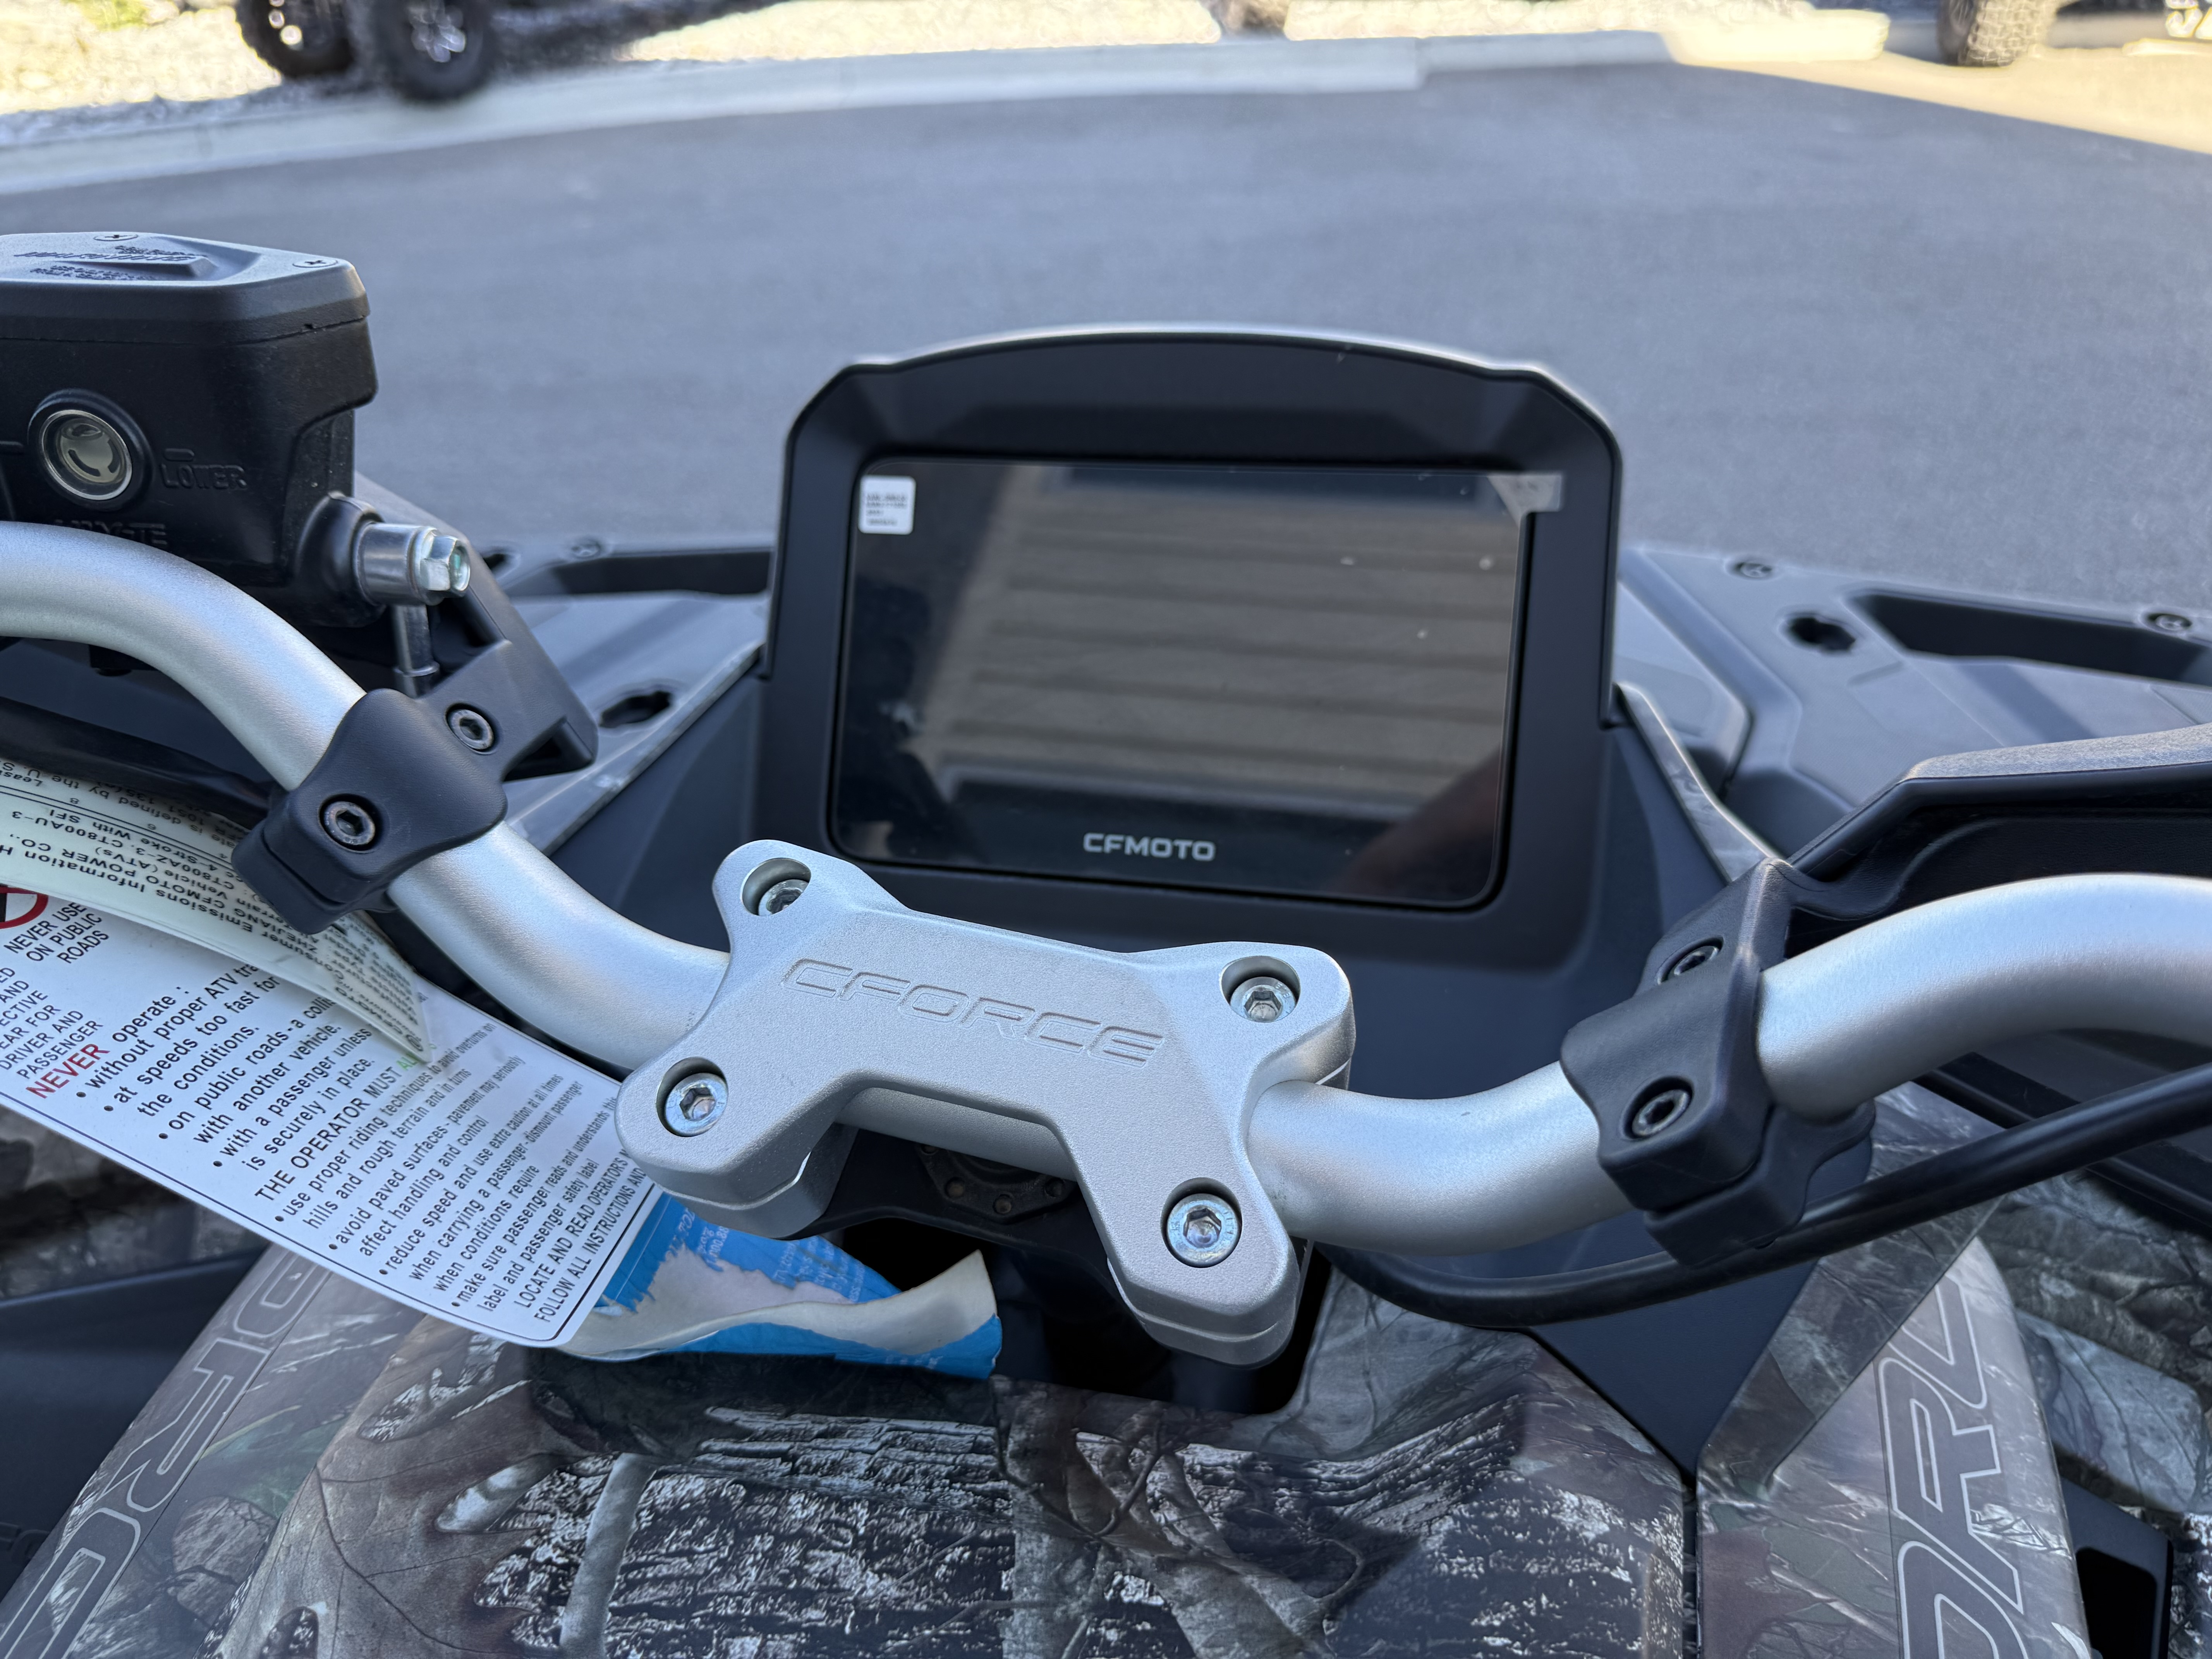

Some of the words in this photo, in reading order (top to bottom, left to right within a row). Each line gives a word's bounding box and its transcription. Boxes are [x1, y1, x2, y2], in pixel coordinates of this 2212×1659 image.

[161, 463, 247, 490] LOWER
[0, 770, 43, 787] Leas
[52, 775, 79, 789] the
[89, 785, 110, 799] by
[50, 809, 81, 823] SFI
[118, 797, 182, 824] defined
[12, 811, 124, 848] CT800AU-3
[93, 822, 132, 840] With
[190, 824, 203, 835] is
[1082, 832, 1216, 862] CFMOTO
[24, 850, 145, 893] Information
[62, 848, 136, 877] POWER
[95, 847, 158, 873] (ATVs)
[141, 838, 218, 871] 4-Stroke
[146, 875, 225, 909] CFMOTO
[165, 869, 228, 900] Vehicle
[3, 921, 59, 954] NEVER
[52, 902, 88, 922] USE
[156, 889, 253, 933] Emissions
[26, 943, 55, 962] ON
[49, 913, 103, 946] PUBLIC
[57, 930, 110, 964] ROADS
[234, 908, 318, 954] ZHEJIANG
[262, 931, 344, 980] Consumer
[0, 981, 29, 1003] AND
[25, 1005, 62, 1027] FOR
[781, 957, 1165, 1067] CFORCE
[0, 1032, 55, 1070] DRIVER
[52, 1010, 84, 1033] AND
[25, 1044, 111, 1099] NEVER
[112, 995, 176, 1043] operate
[84, 1039, 155, 1089] without
[153, 996, 208, 1041] proper
[204, 973, 239, 1000] ATV
[113, 1085, 138, 1103] at
[137, 1038, 199, 1085] speeds
[195, 1015, 228, 1036] too
[223, 990, 261, 1013] fast
[254, 976, 281, 993] for
[16, 1020, 104, 1079] PASSENGER
[137, 1094, 173, 1117] the
[173, 1025, 260, 1091] conditions.
[193, 1113, 235, 1144] with
[233, 1061, 292, 1111] another
[289, 1024, 342, 1061] vehicle.
[440, 1081, 456, 1093] in
[447, 1068, 472, 1085] turns
[541, 1073, 565, 1093] times
[168, 1111, 196, 1130] on
[194, 1067, 247, 1110] public
[219, 1127, 258, 1157] with
[255, 1116, 272, 1127] a
[267, 1056, 337, 1118] passenger
[333, 1028, 373, 1057] unless
[425, 1088, 447, 1108] and
[528, 1097, 539, 1109] at
[535, 1087, 549, 1103] all
[241, 1156, 266, 1171] is
[264, 1100, 327, 1154] securely
[317, 1086, 341, 1100] in
[337, 1058, 376, 1089] place.
[283, 1192, 311, 1216] use
[308, 1149, 352, 1193] proper
[349, 1116, 389, 1150] riding
[380, 1071, 434, 1116] techniques
[428, 1065, 442, 1074] to
[438, 1048, 460, 1068] avoid
[455, 1030, 489, 1055] overturns
[483, 1022, 498, 1033] on
[390, 1105, 430, 1139] terrain
[506, 1104, 534, 1131] caution
[254, 1169, 297, 1201] THE
[290, 1097, 371, 1169] OPERATOR
[362, 1066, 402, 1099] MUST
[335, 1206, 373, 1245] avoid
[368, 1168, 408, 1211] paved
[479, 1078, 501, 1097] may
[492, 1054, 526, 1082] seriously
[489, 1128, 513, 1149] extra
[359, 1139, 398, 1175] rough
[473, 1147, 494, 1167] use
[336, 1172, 364, 1199] and
[359, 1219, 398, 1257] affect
[388, 1167, 446, 1220] handling
[438, 1144, 462, 1168] and
[457, 1114, 489, 1147] control
[409, 1249, 443, 1281] when
[437, 1198, 485, 1249] carrying
[477, 1188, 492, 1199] a
[550, 1080, 584, 1116] passenger
[454, 1163, 479, 1190] and
[302, 1200, 339, 1230] hills
[422, 1187, 459, 1228] speed
[457, 1272, 487, 1303] make
[481, 1244, 507, 1272] sure
[502, 1185, 551, 1246] passenger
[544, 1164, 568, 1188] reads
[562, 1148, 579, 1167] and
[573, 1109, 611, 1153] understands
[433, 1261, 466, 1292] when
[460, 1199, 512, 1261] conditions
[508, 1164, 540, 1199] require
[476, 1283, 510, 1312] label
[503, 1260, 526, 1285] and
[520, 1202, 567, 1264] passenger
[562, 1177, 589, 1203] safety
[576, 1158, 600, 1179] label
[534, 1276, 576, 1323] FOLLOW
[567, 1256, 592, 1279] ALL
[582, 1184, 636, 1255] INSTRUCTIONS
[627, 1167, 647, 1187] AND
[385, 1228, 426, 1270] reduce
[513, 1262, 556, 1309] LOCATE
[547, 1236, 574, 1265] AND
[565, 1203, 596, 1238] READ
